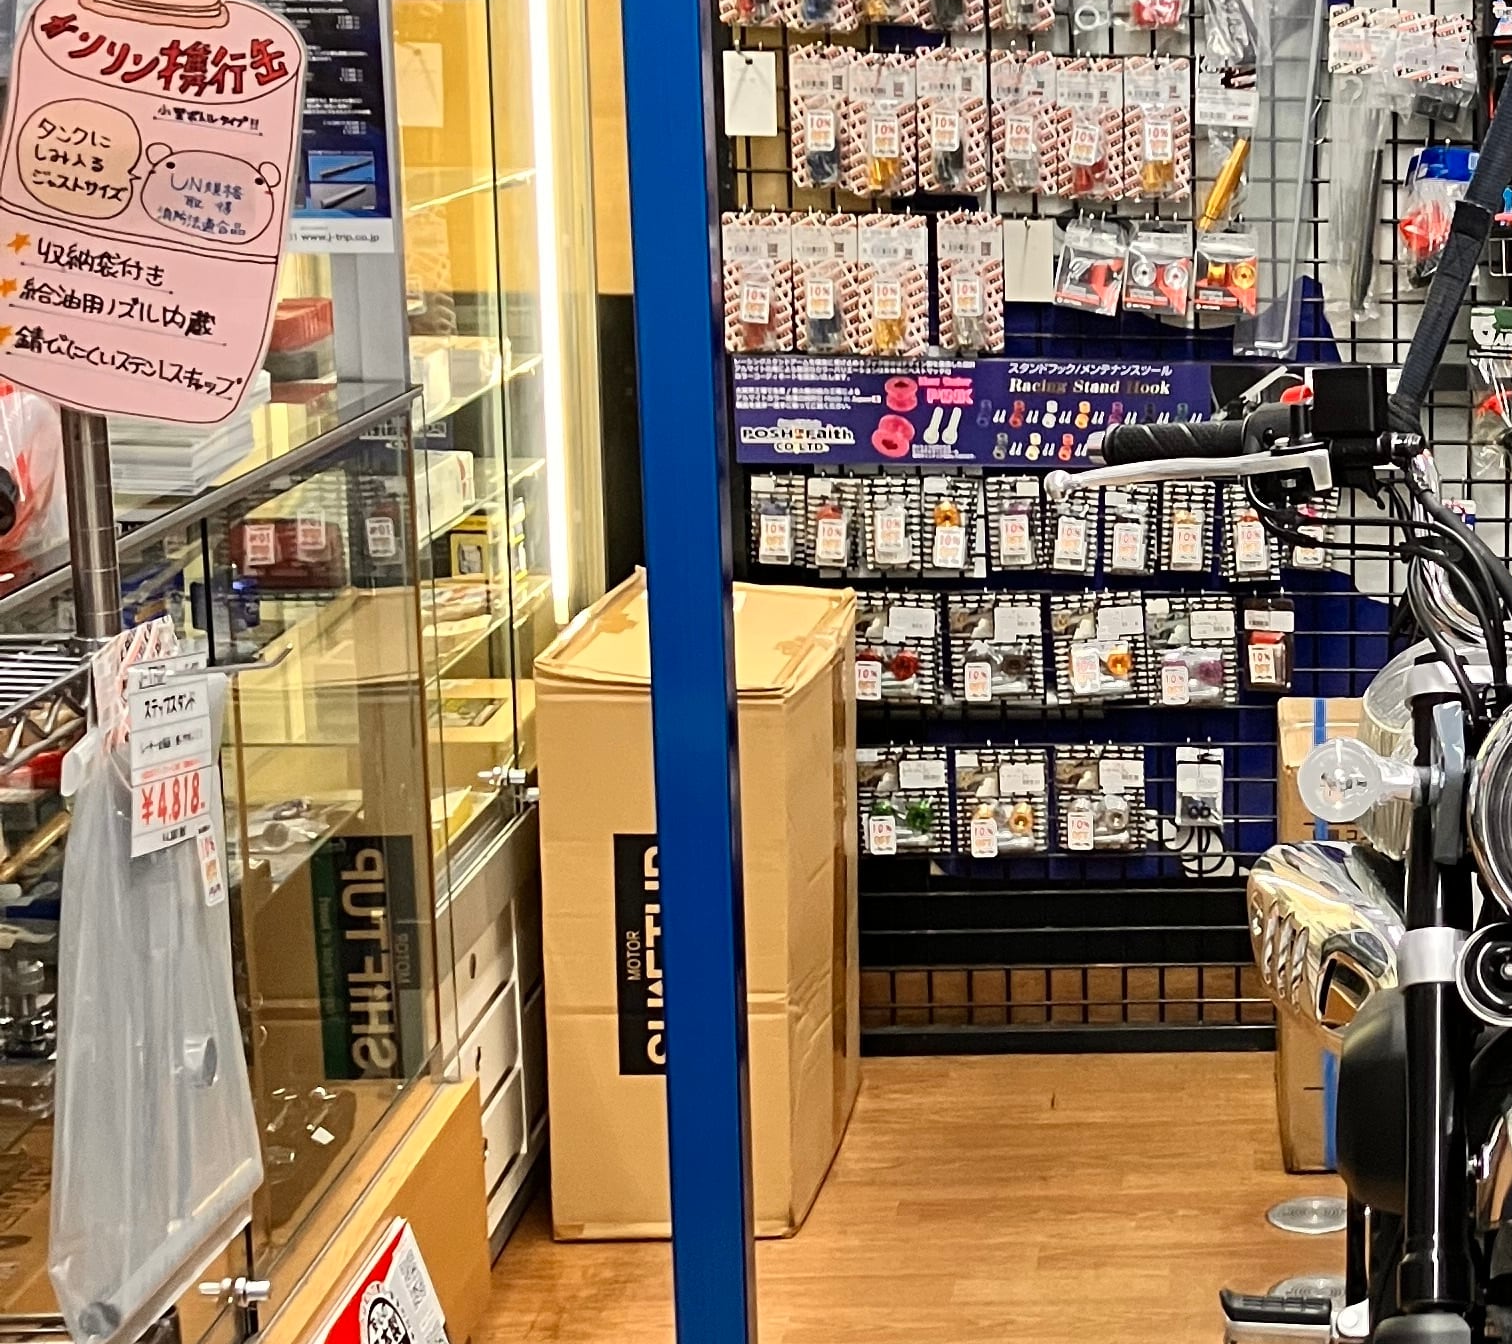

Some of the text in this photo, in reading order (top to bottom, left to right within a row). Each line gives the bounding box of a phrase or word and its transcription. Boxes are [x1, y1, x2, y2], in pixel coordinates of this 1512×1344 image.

[37, 117, 112, 149] タンクに
[37, 236, 166, 288] 収納袋付き
[19, 276, 217, 338] 給油用ノズル内蔵
[14, 324, 244, 398] 錆びにくいステンレスキャップ
[1008, 362, 1173, 377] スタンドフック/メンテナンスツール
[1009, 377, 1171, 395] Racing Stand Hook
[742, 426, 853, 440] POSH Faith
[626, 930, 641, 981] MOTOR
